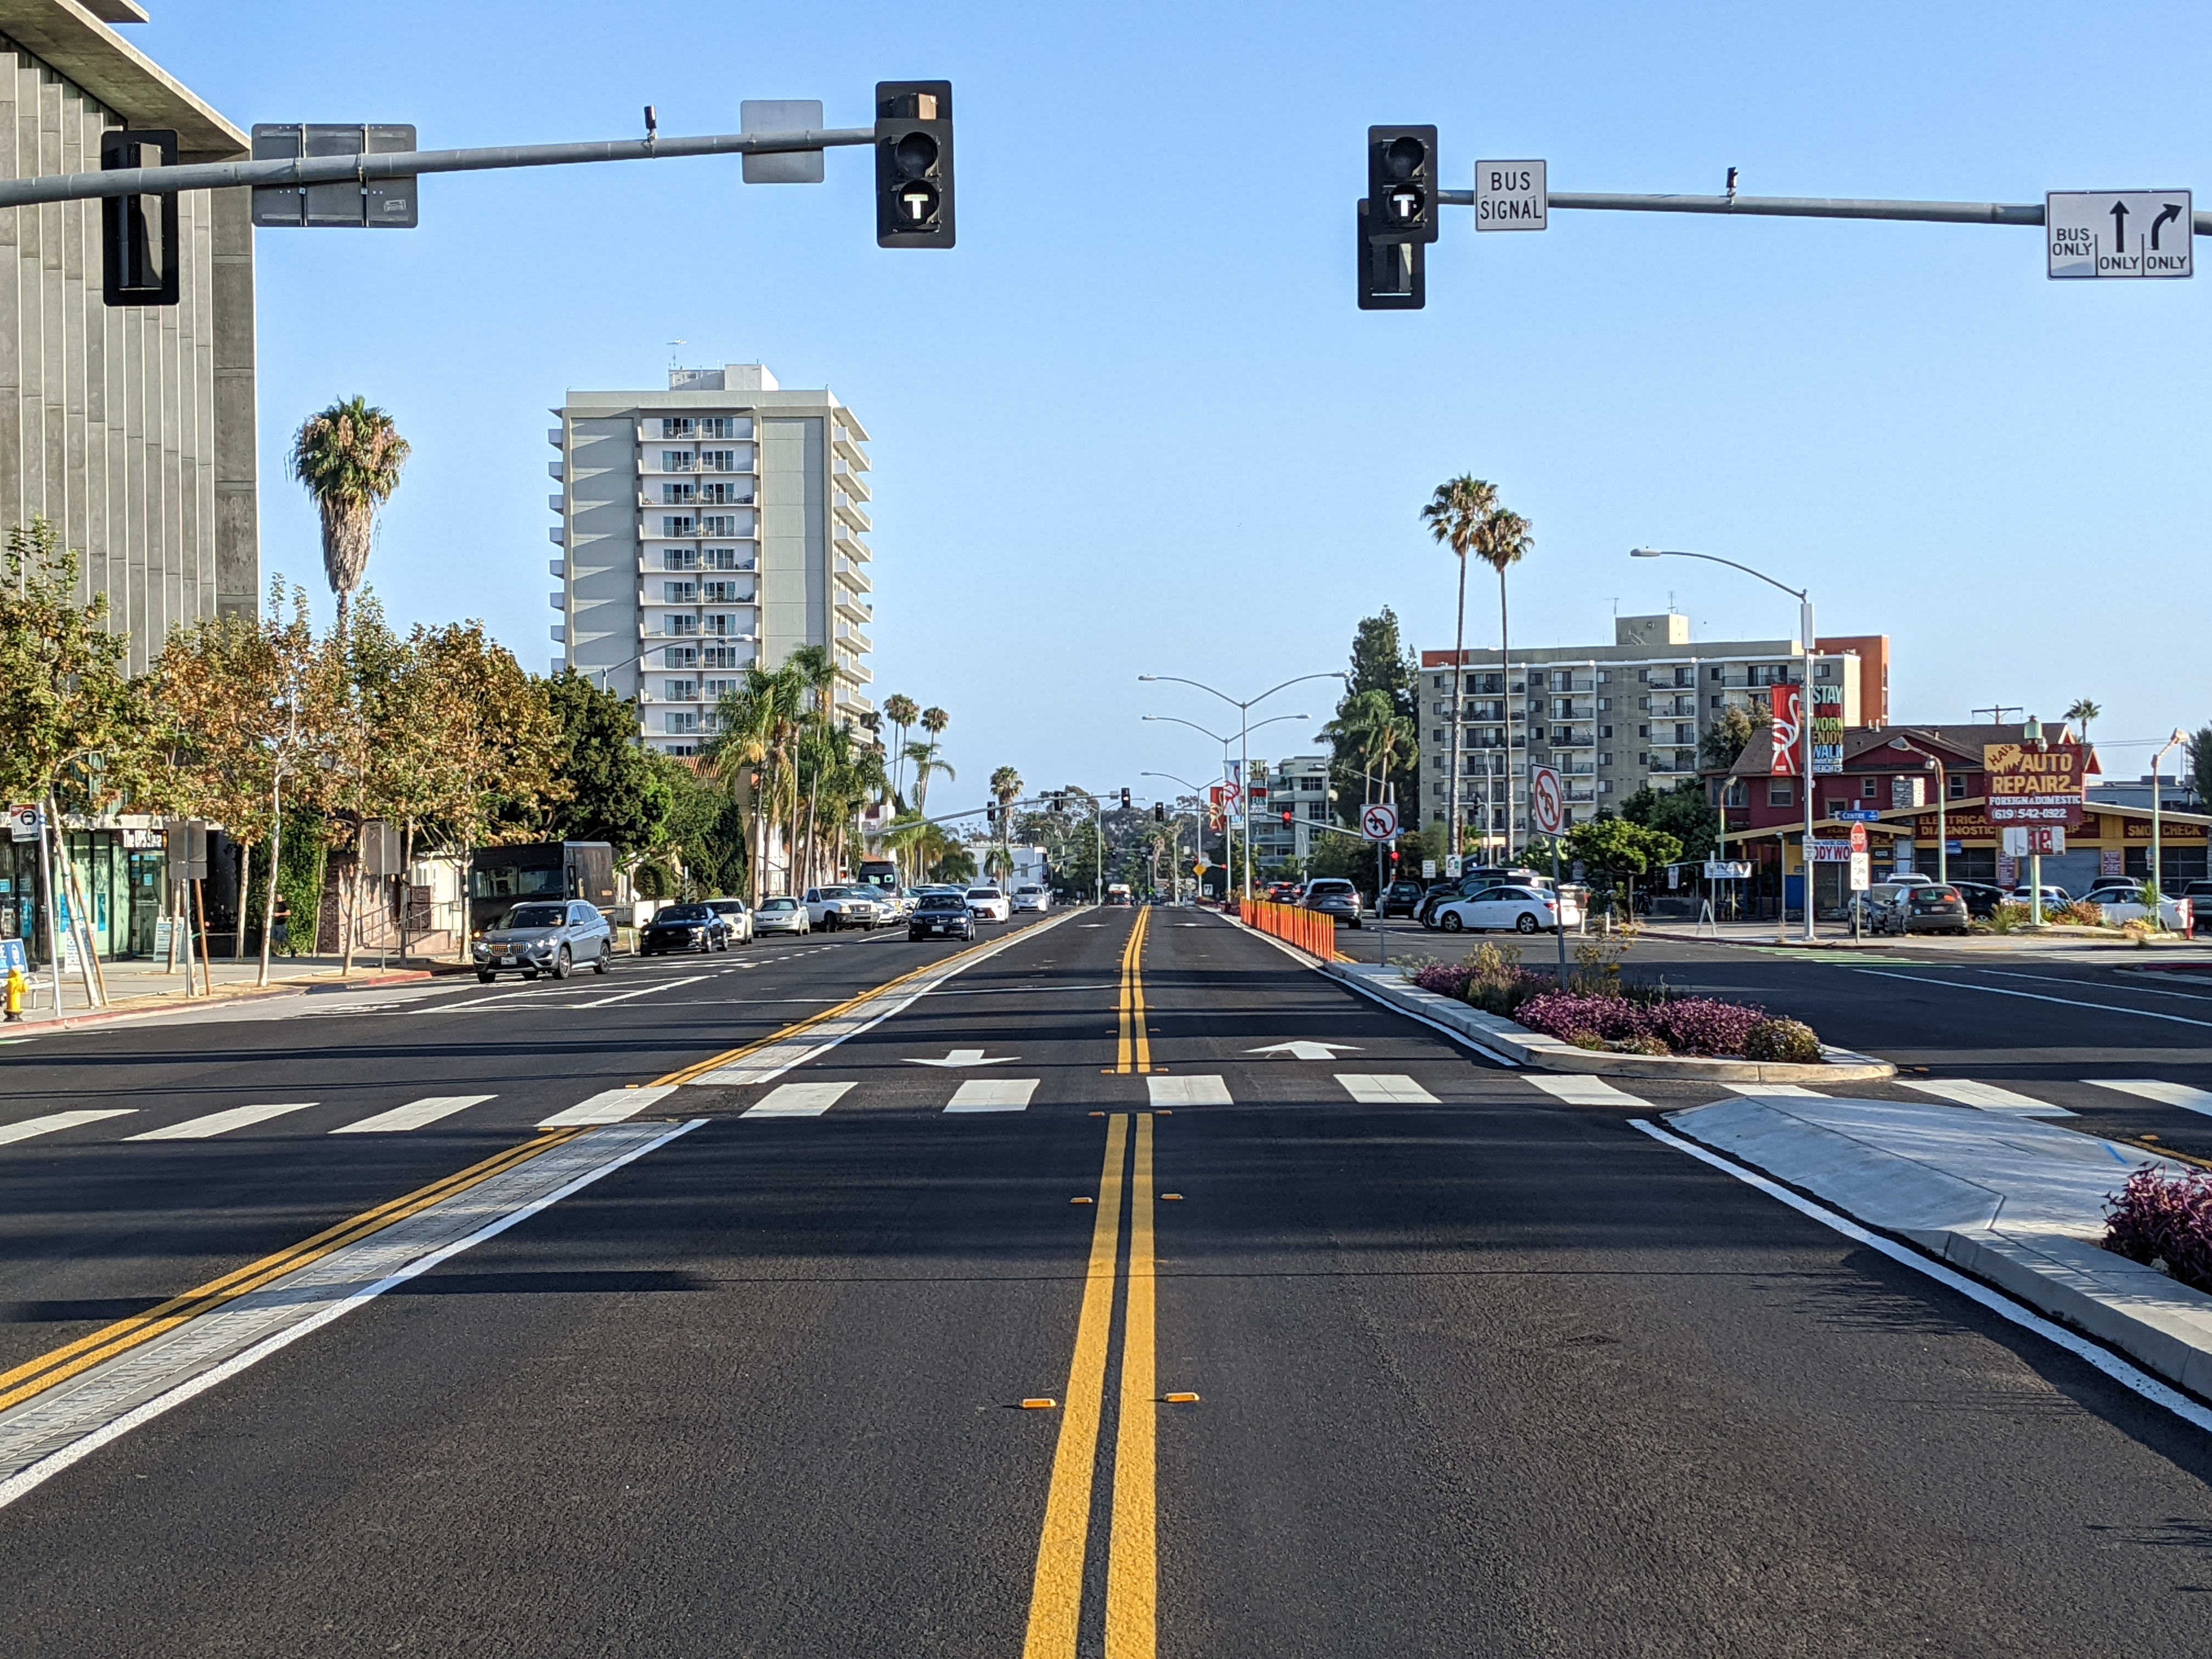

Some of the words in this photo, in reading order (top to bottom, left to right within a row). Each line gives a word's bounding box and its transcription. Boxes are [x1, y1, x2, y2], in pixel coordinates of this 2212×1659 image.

[1491, 171, 1530, 191] BUS
[1480, 200, 1542, 219] SIGNAL
[2057, 228, 2090, 241] BUS
[2052, 242, 2093, 256] ONLY
[2100, 256, 2140, 270] ONLY
[2147, 256, 2187, 269] ONLY
[1813, 685, 1842, 704] STAY
[1813, 731, 1843, 744] ENJOY
[2019, 753, 2073, 772] AUTO
[2128, 825, 2152, 837] SMO
[2163, 825, 2202, 836] CHECK
